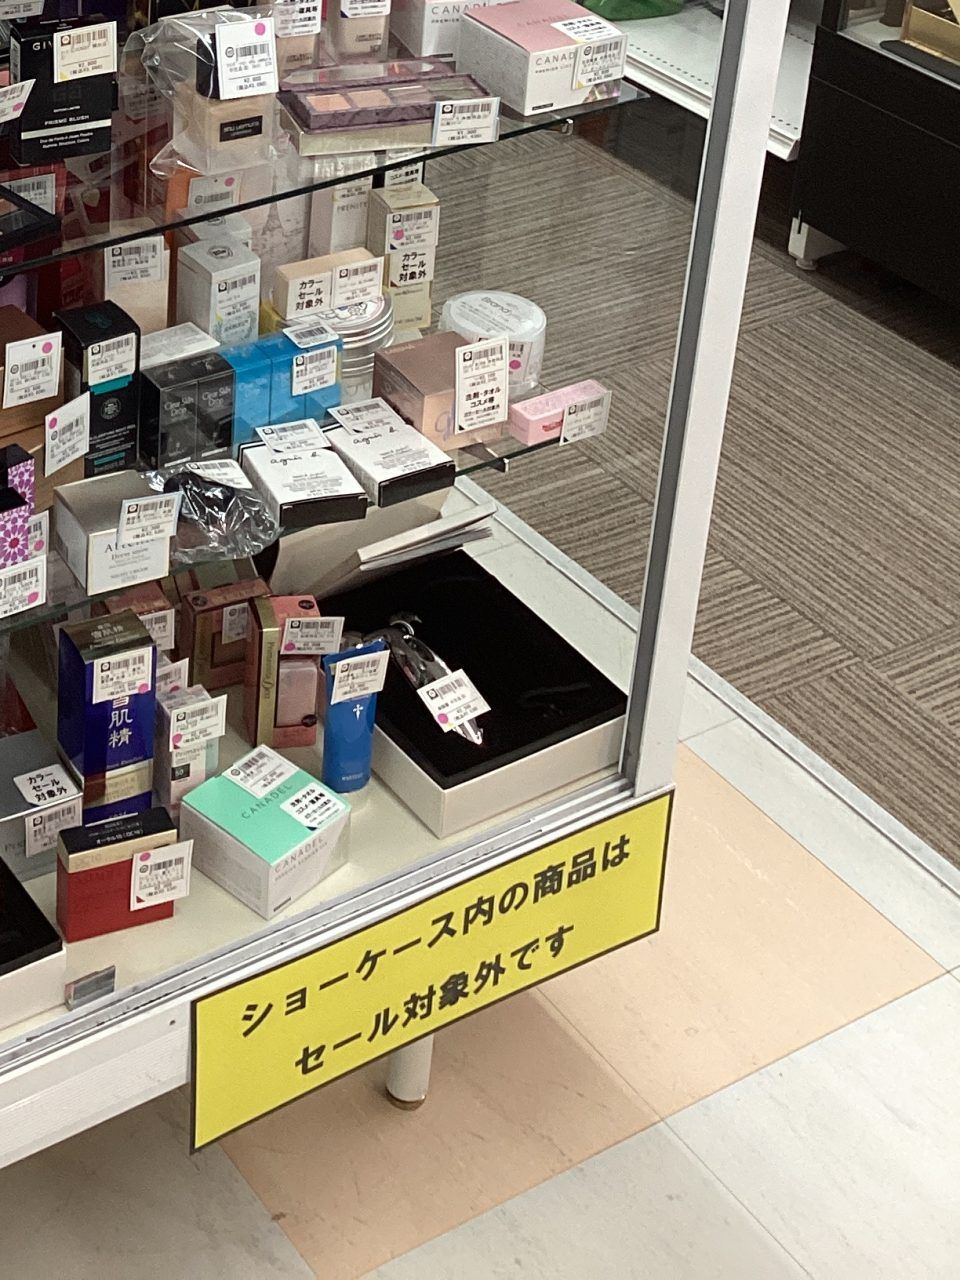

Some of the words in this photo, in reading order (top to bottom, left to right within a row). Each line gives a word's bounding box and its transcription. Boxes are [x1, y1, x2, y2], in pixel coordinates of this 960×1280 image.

[402, 251, 427, 263] カラー
[402, 261, 427, 272] セール
[399, 271, 427, 282] 対象外
[298, 279, 324, 290] カラー
[298, 288, 324, 300] セール
[295, 299, 324, 311] 対象外
[27, 771, 54, 785] カラー
[36, 778, 61, 794] セール
[34, 786, 69, 803] 対象外
[241, 783, 293, 820] CANADEL
[274, 836, 324, 873] CANADEL
[242, 835, 630, 1038] ショーケース内の商品は
[295, 925, 575, 1076] セール対象外です
